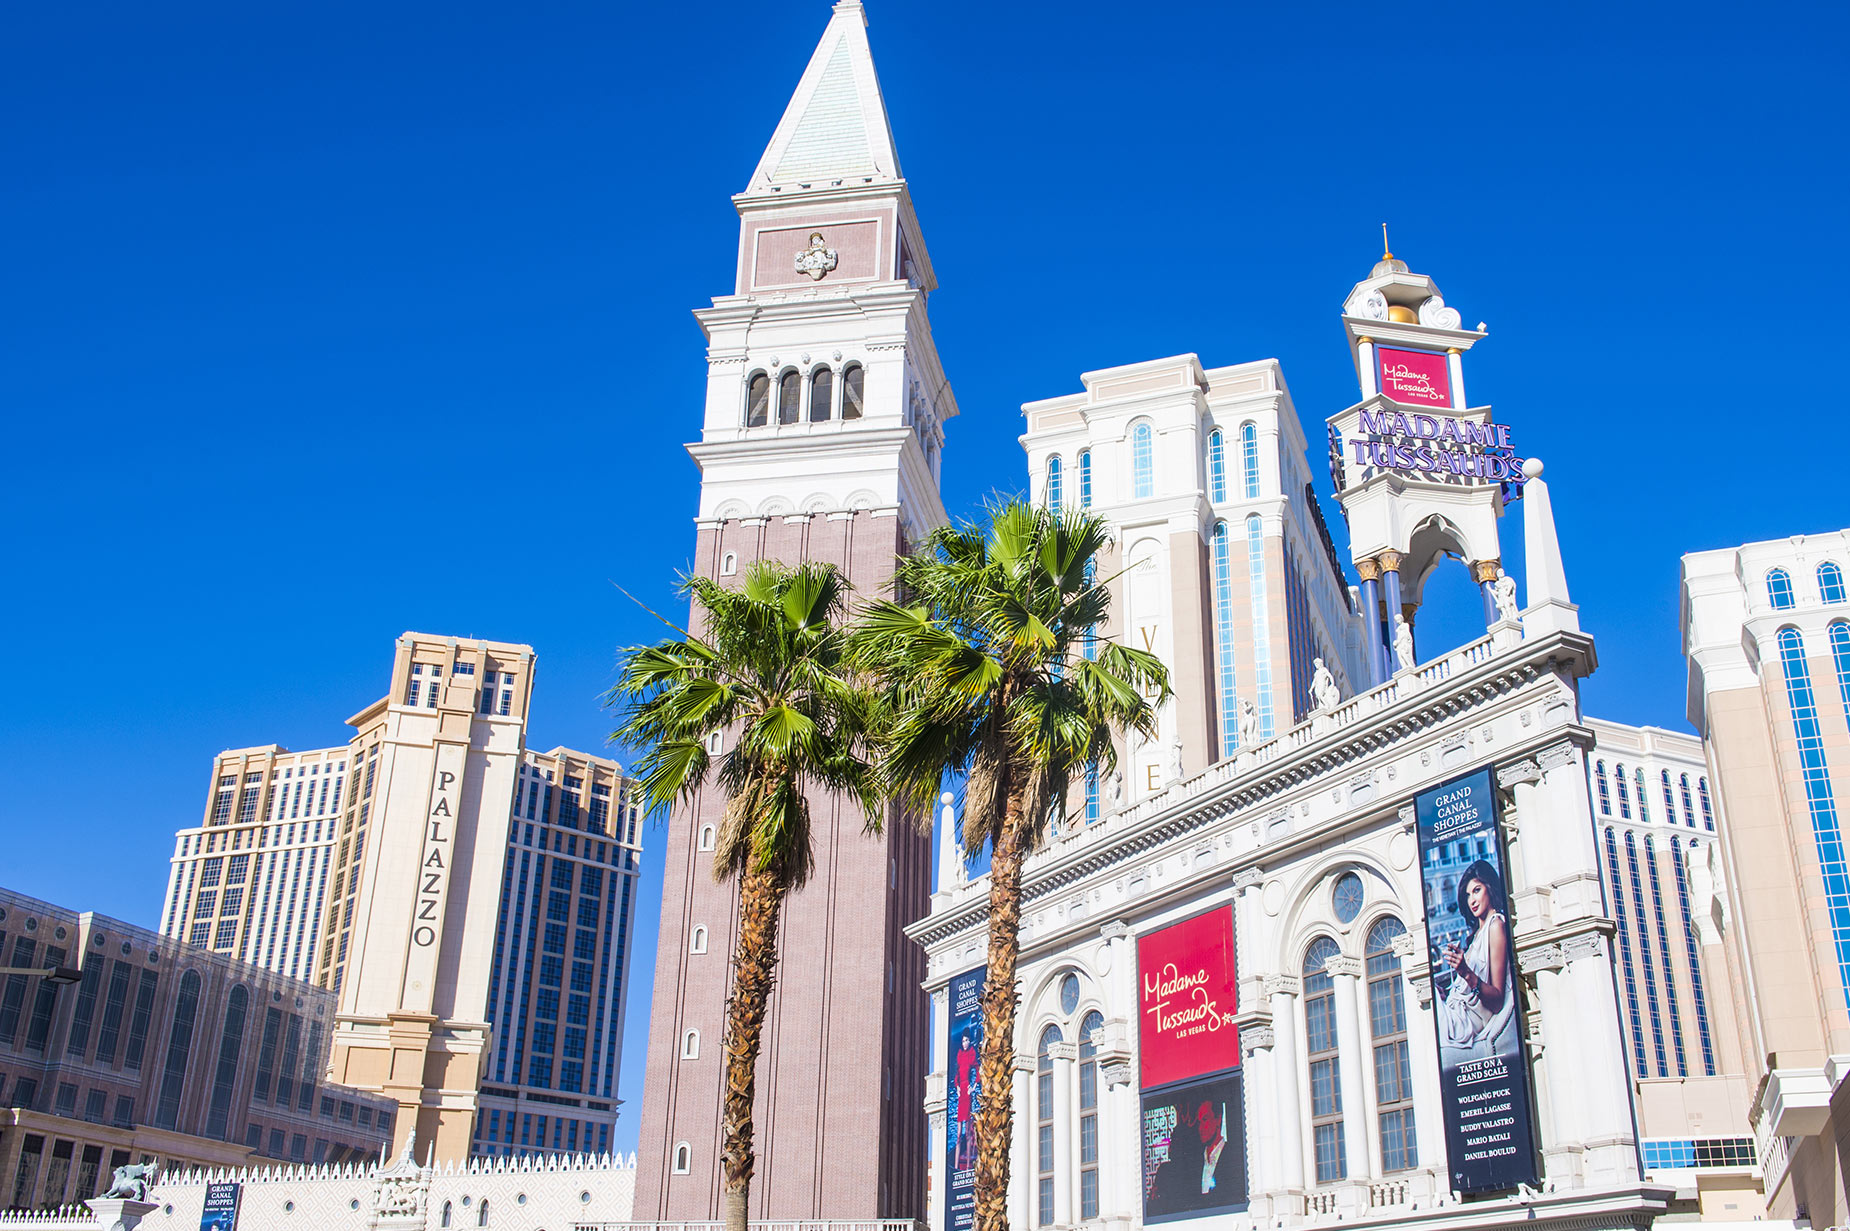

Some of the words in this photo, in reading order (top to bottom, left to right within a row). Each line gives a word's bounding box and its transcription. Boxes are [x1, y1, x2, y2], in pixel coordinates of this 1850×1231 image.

[1384, 363, 1430, 380] Madame
[1386, 378, 1438, 400] Tussauds
[1359, 408, 1515, 450] MADAME
[1435, 786, 1472, 808] GRAND
[1437, 798, 1473, 819] CANAL
[1433, 807, 1479, 833] SHOPPES
[414, 771, 456, 947] PALAZZO
[958, 979, 977, 992] GRAND
[1145, 963, 1209, 1002] Madame
[956, 995, 978, 1010] SHOPPES
[958, 988, 976, 1001] CANAL
[1147, 987, 1221, 1034] Tussauds
[1176, 1030, 1187, 1039] LAS
[1188, 1024, 1206, 1036] VEGAS
[1456, 1071, 1483, 1083] GRAND
[1483, 1065, 1508, 1078] SCALE
[1459, 1062, 1483, 1074] TASTE
[1483, 1059, 1496, 1069] ON
[1496, 1058, 1503, 1067] A
[1457, 1091, 1492, 1105] WOLFGANG
[1492, 1088, 1511, 1098] PUCK
[1460, 1107, 1484, 1118] EMERIL
[1484, 1102, 1511, 1114] LAGASSE
[1460, 1122, 1481, 1133] BUDDY
[1481, 1117, 1515, 1129] VALASTRO
[1466, 1135, 1488, 1146] MARIO
[1488, 1132, 1511, 1143] BATALI
[1464, 1150, 1488, 1161] DANIEL
[1488, 1146, 1517, 1157] BOULUD
